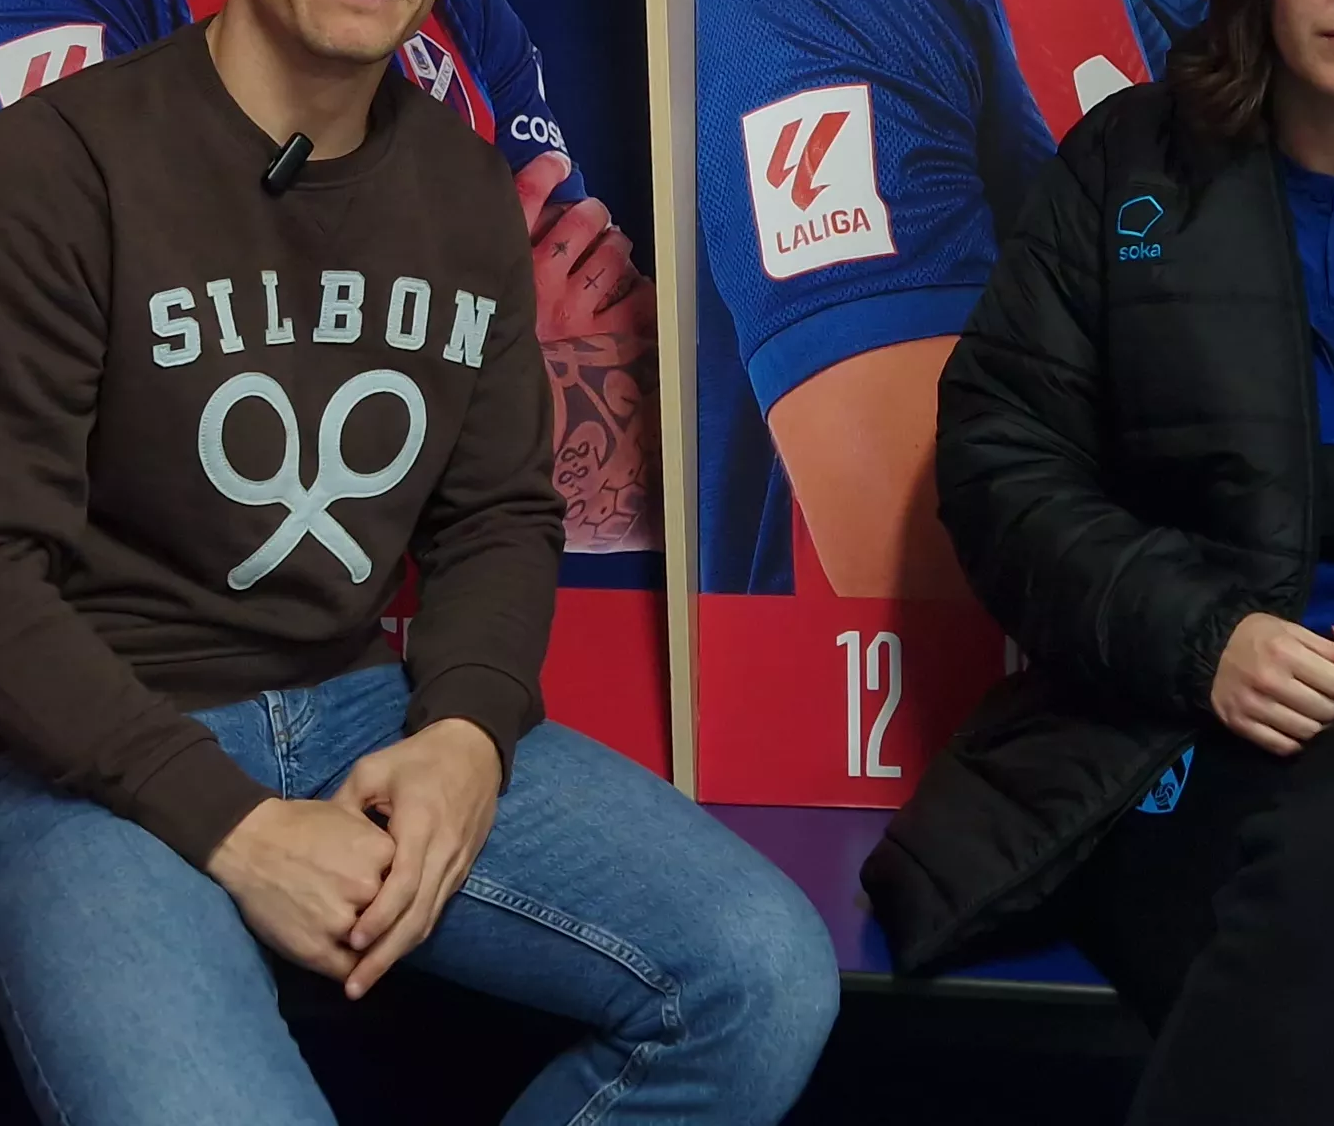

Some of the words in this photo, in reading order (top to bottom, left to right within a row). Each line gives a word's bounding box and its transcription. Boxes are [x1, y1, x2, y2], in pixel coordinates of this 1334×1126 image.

[776, 207, 871, 254] LALIGA
[1119, 242, 1161, 261] soka
[148, 270, 497, 368] SILBON
[836, 630, 902, 778] 12
